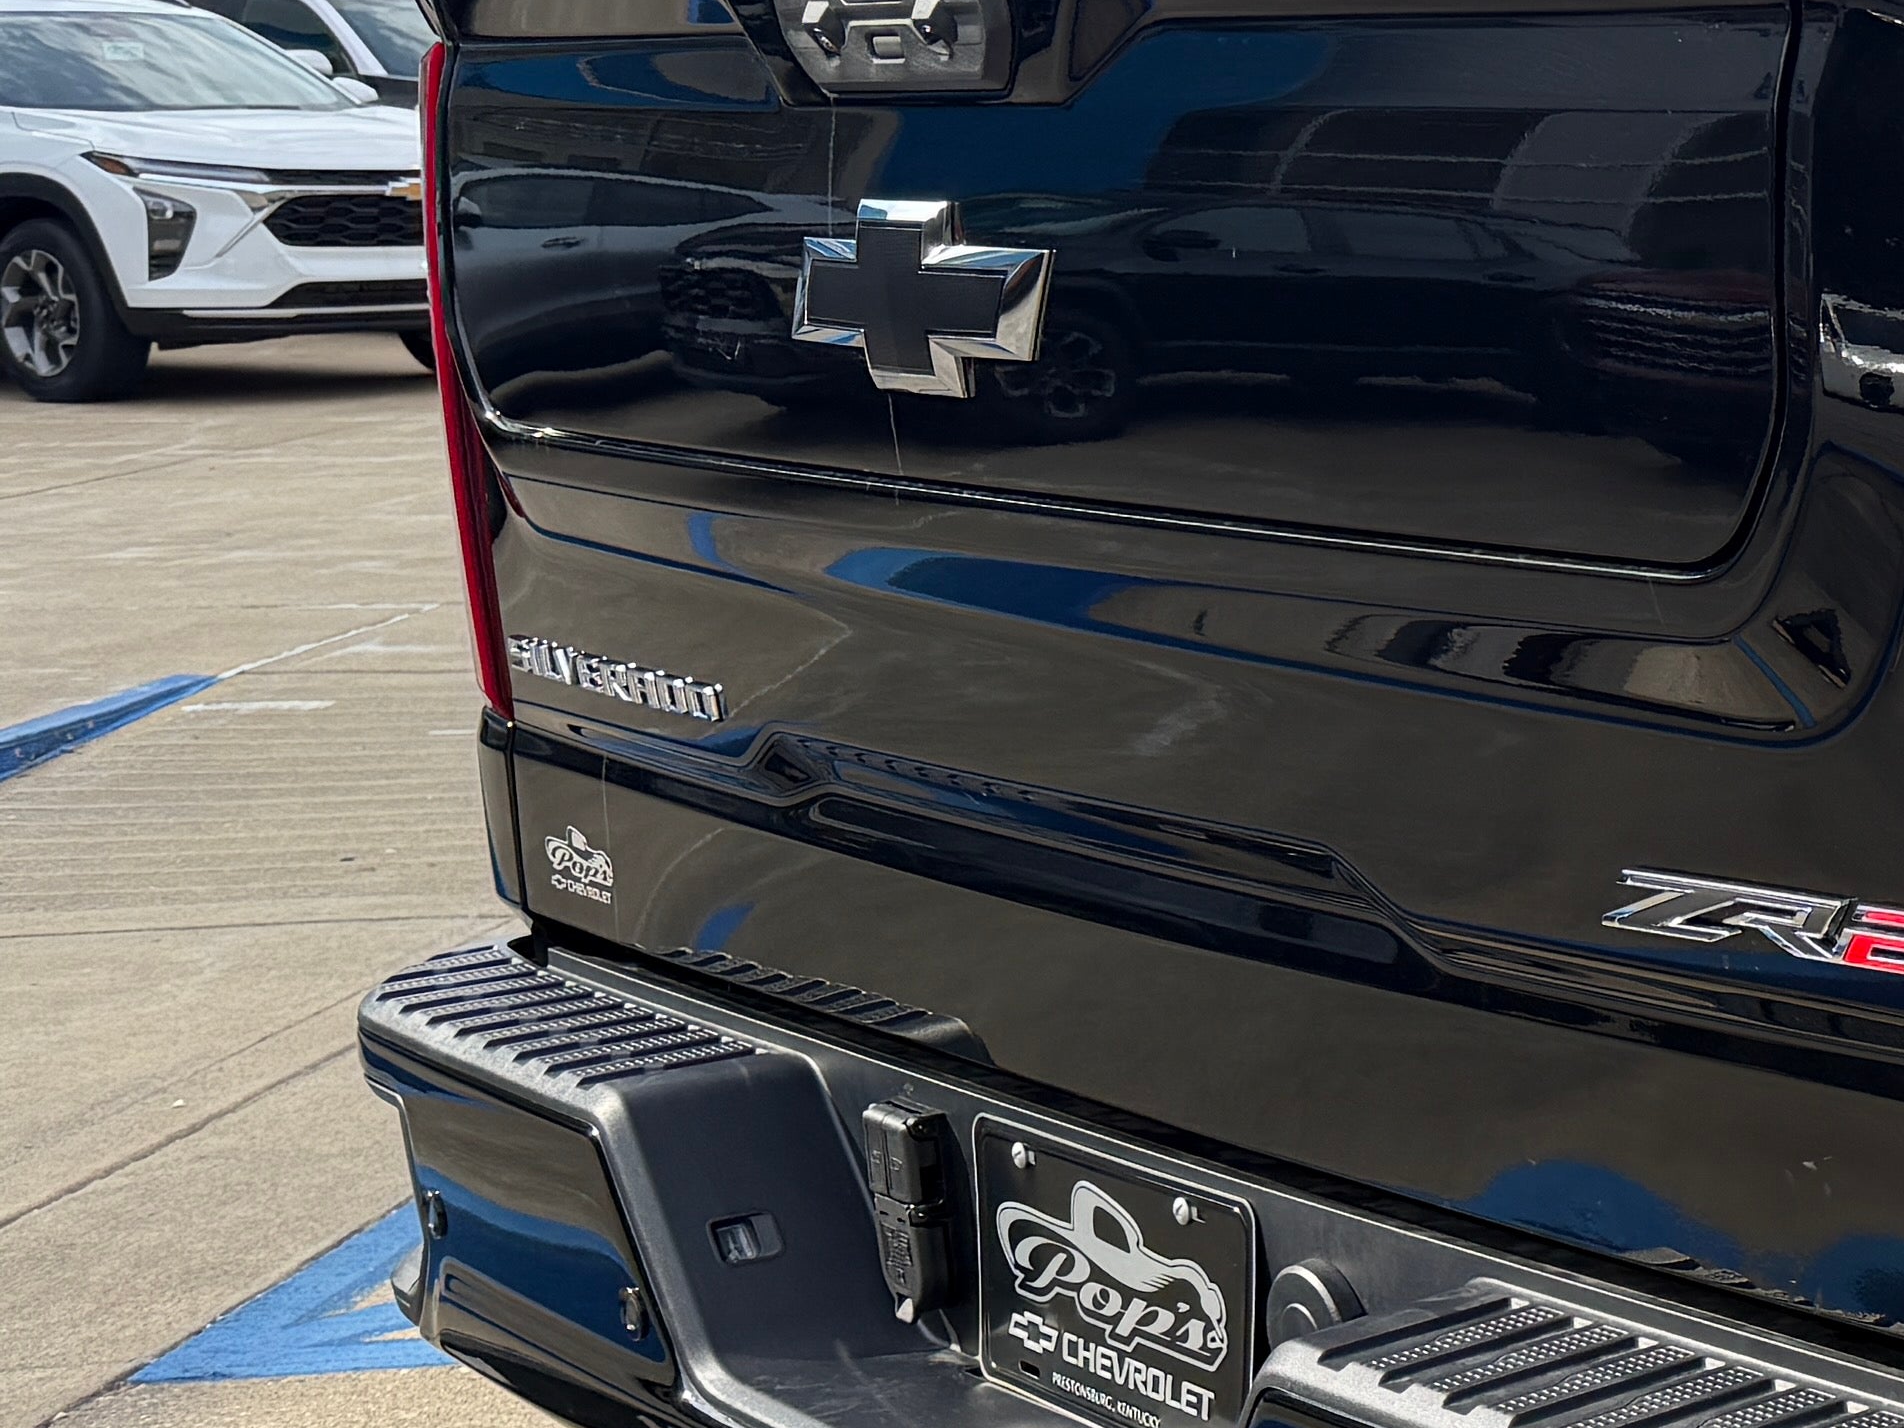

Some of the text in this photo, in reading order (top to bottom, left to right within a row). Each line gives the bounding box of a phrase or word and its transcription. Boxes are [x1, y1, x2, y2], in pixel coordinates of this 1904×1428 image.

[506, 633, 729, 723] SILVERADO
[1013, 1234, 1213, 1357] Pop's
[1061, 1330, 1216, 1422] CHEVROLET
